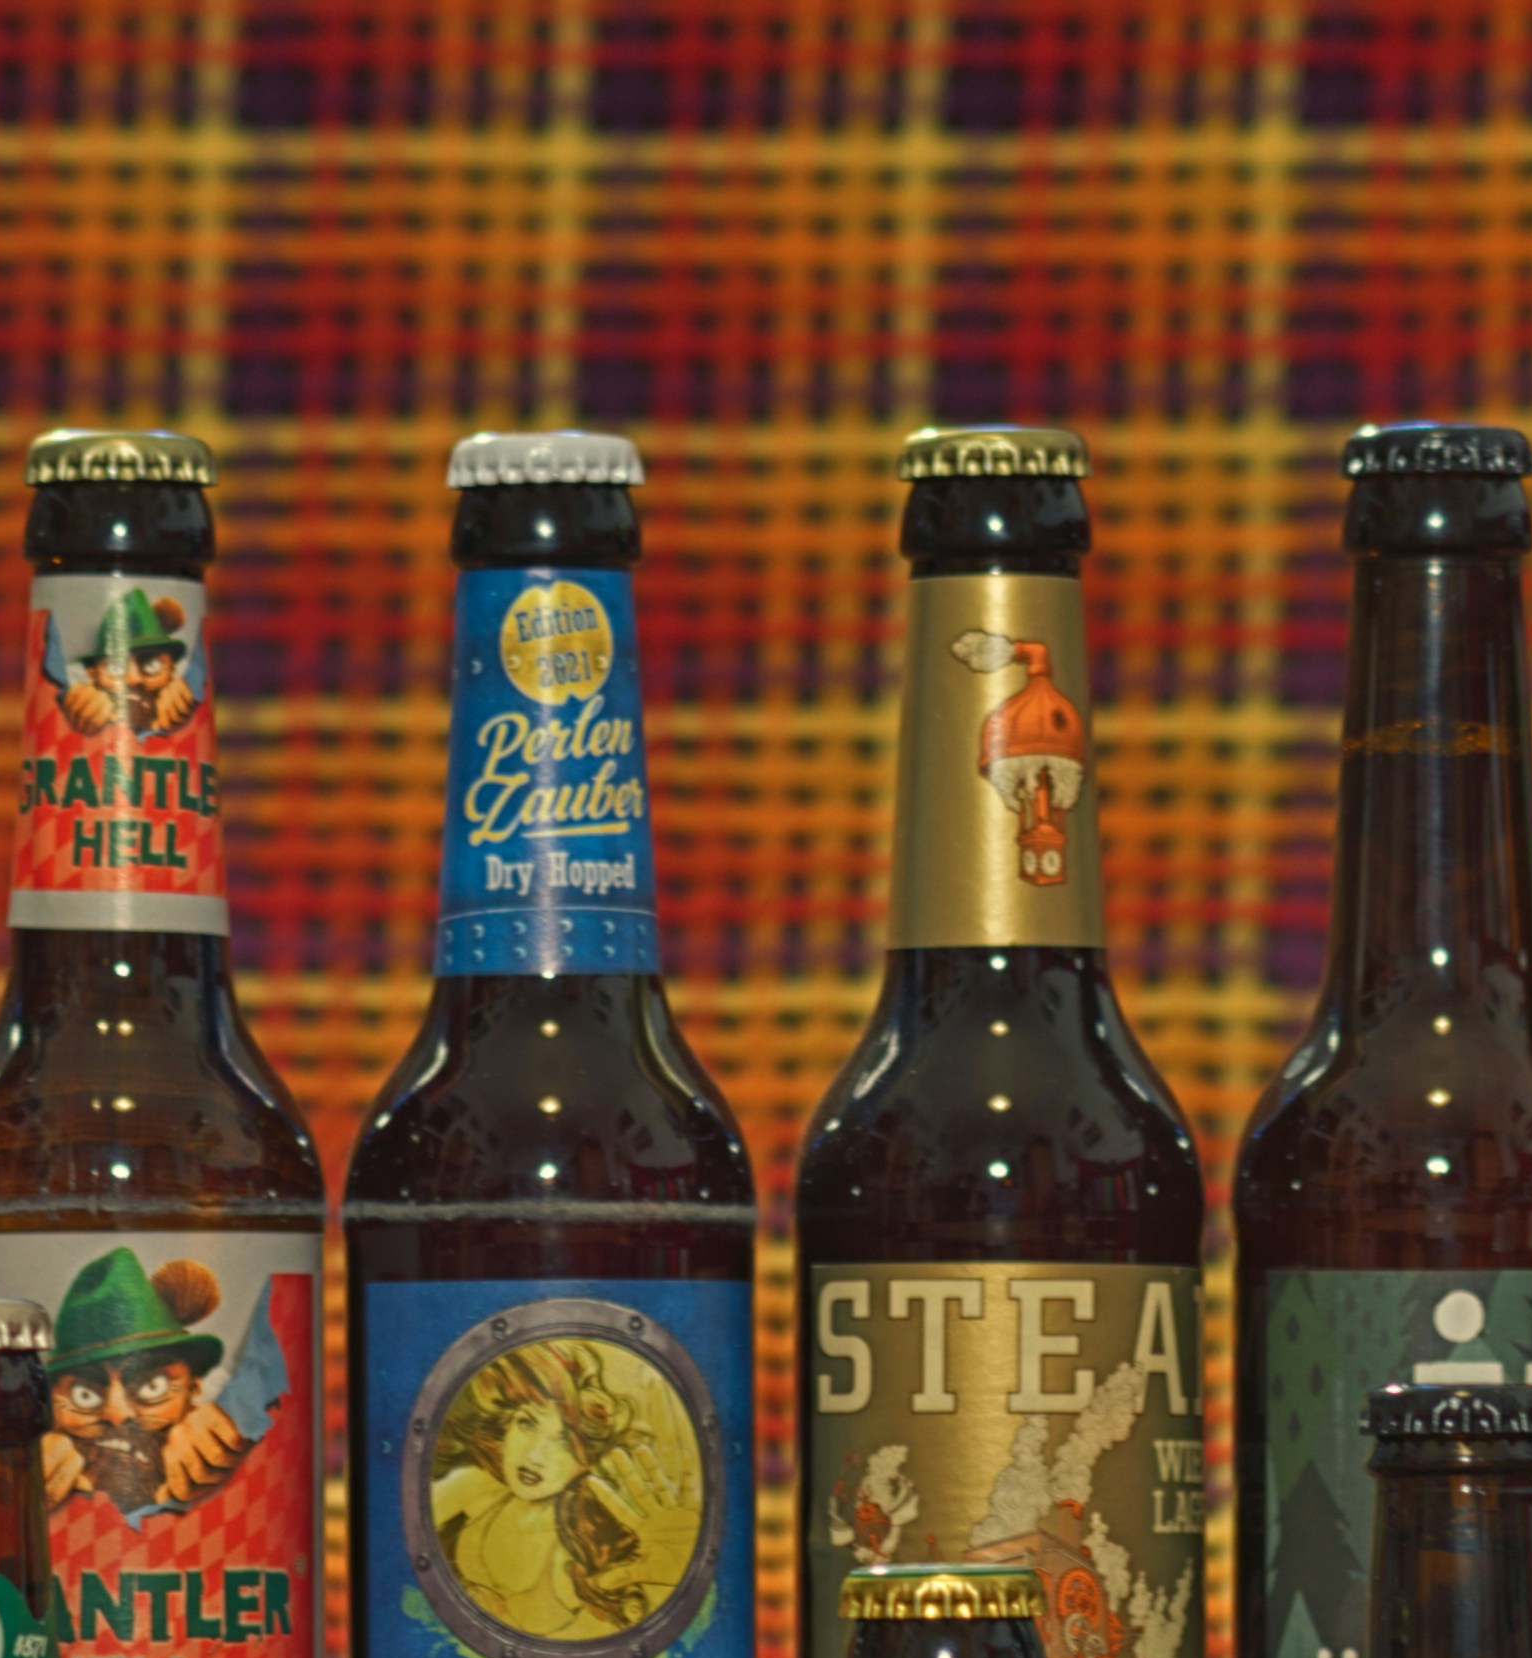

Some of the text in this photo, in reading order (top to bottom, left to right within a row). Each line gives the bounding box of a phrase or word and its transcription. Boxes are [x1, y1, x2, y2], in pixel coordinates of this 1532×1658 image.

[515, 605, 599, 643] Edition
[536, 650, 594, 688] 2021
[478, 695, 633, 777] Perlen
[464, 760, 645, 846] Zauber
[73, 820, 187, 868] HELL
[485, 850, 637, 896] Dry Hopped
[816, 1279, 1205, 1416] STEA
